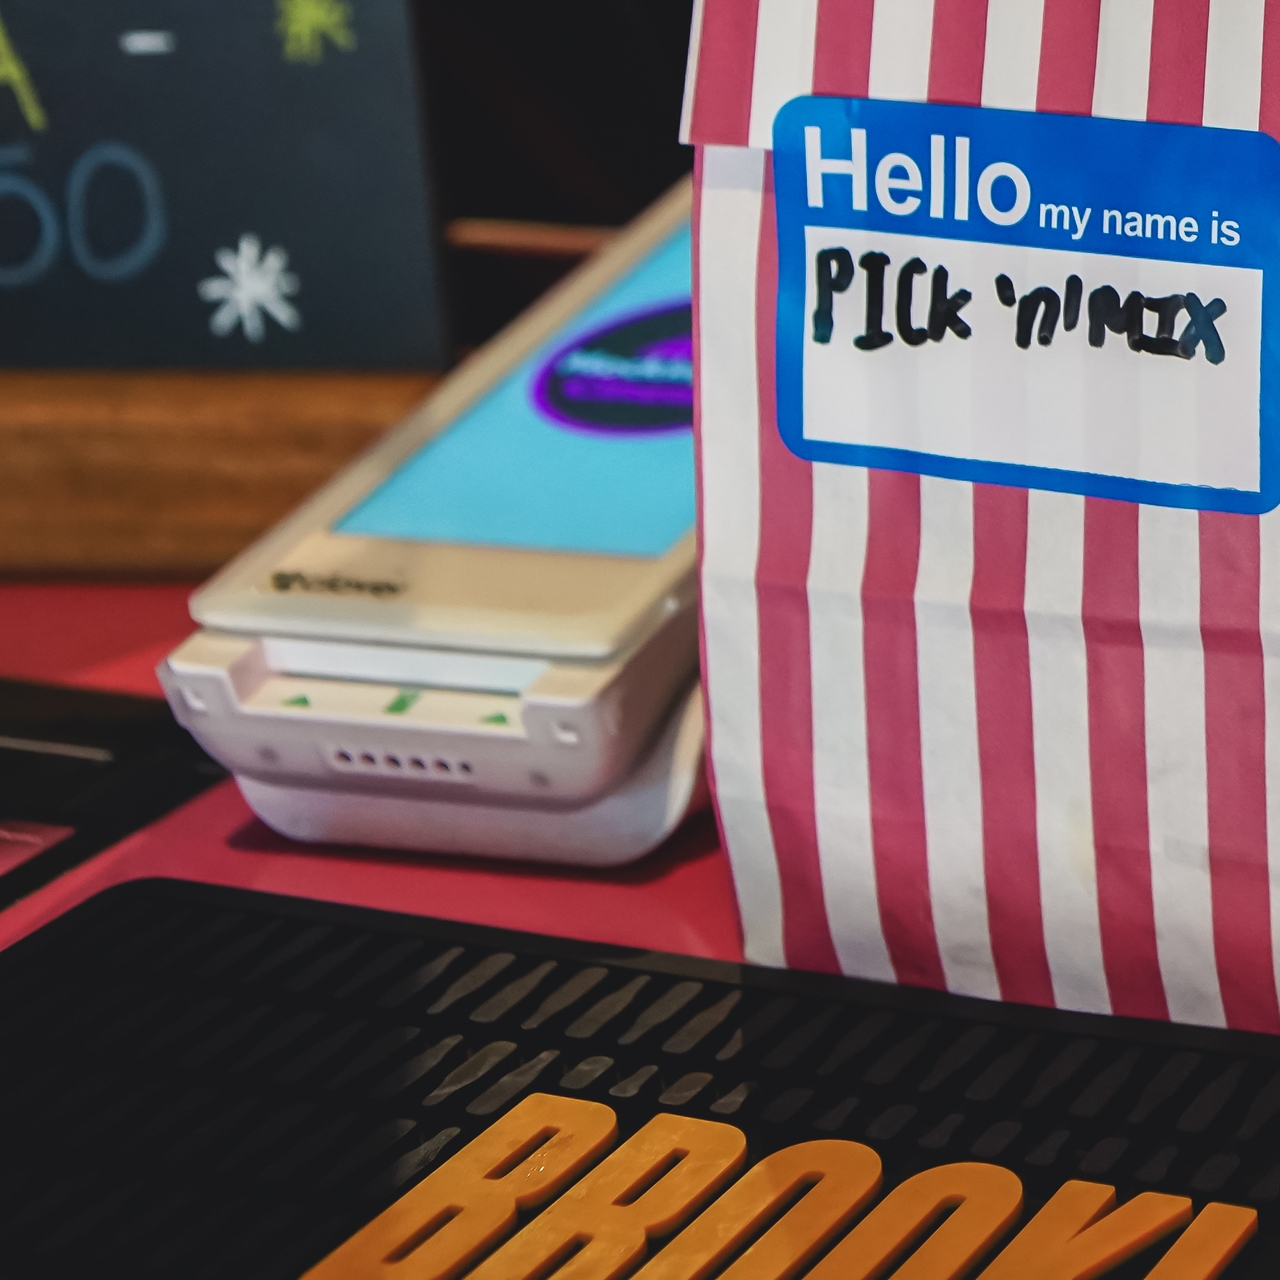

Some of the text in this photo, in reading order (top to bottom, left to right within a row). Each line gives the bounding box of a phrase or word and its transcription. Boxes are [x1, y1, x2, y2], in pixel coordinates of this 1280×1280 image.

[803, 126, 1241, 248] Hello my name is
[1086, 283, 1228, 365] MIX
